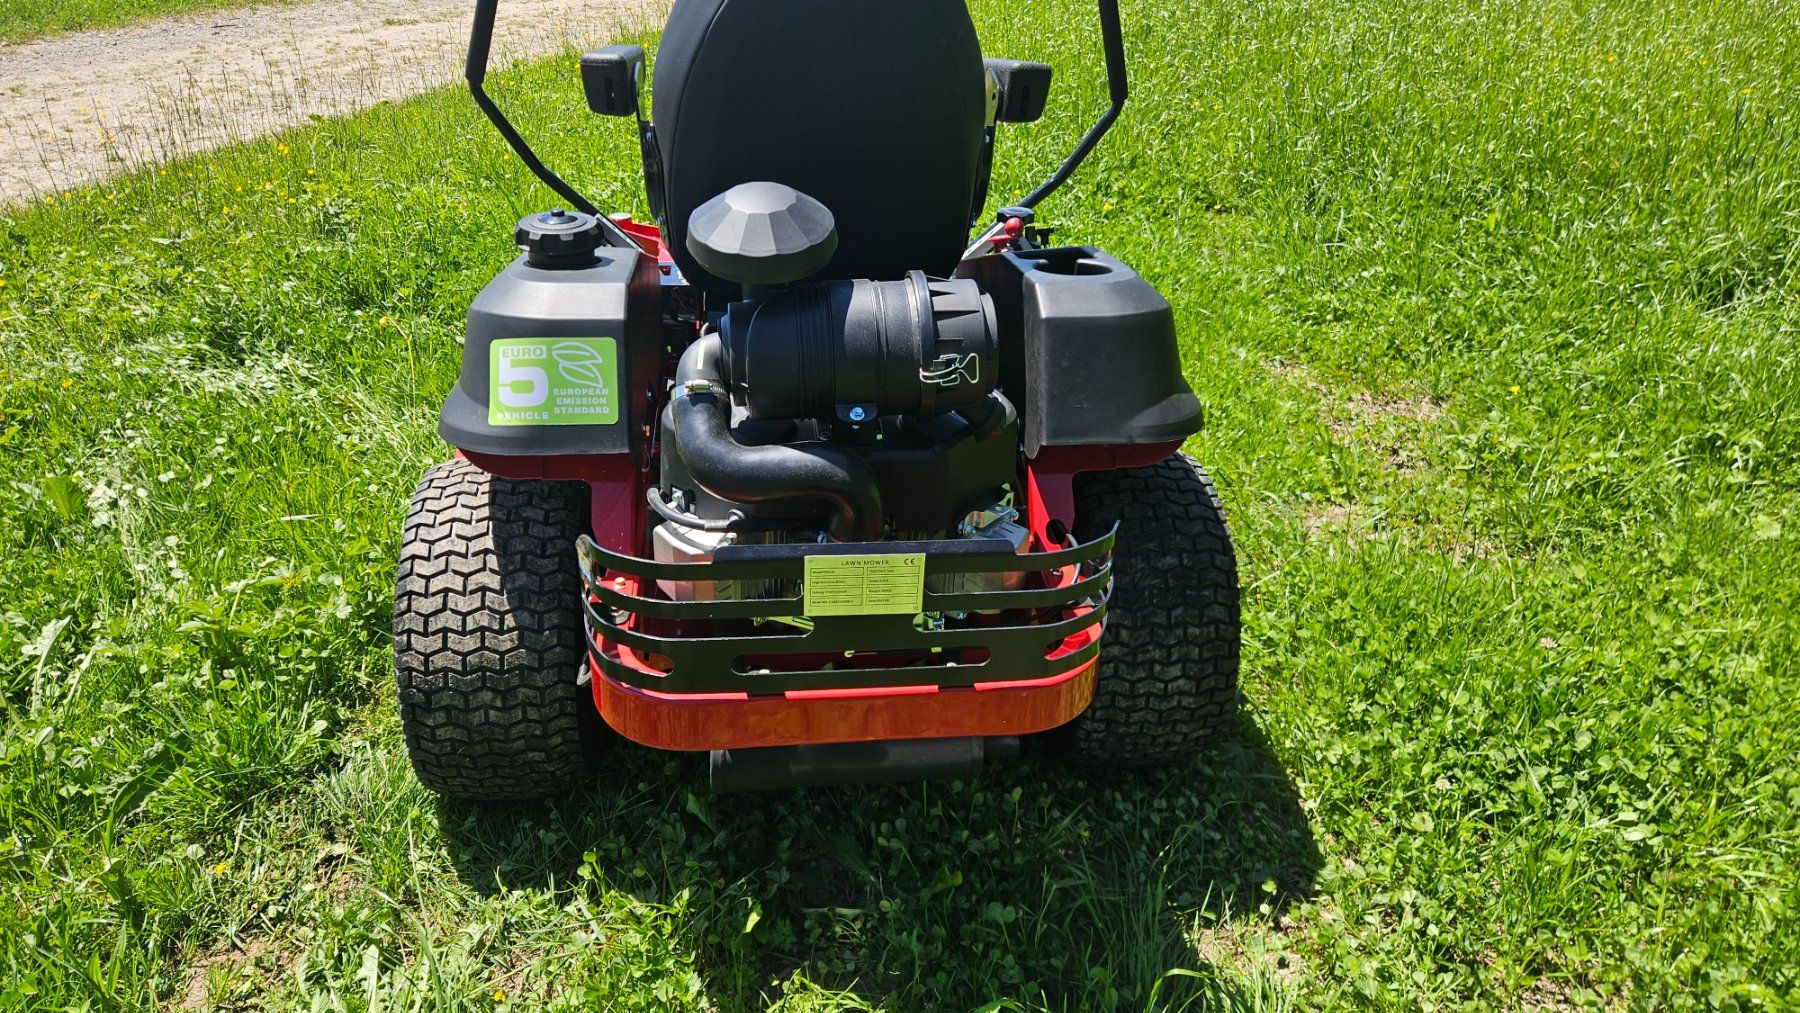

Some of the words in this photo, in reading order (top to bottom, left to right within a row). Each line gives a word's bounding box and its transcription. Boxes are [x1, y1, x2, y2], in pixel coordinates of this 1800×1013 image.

[502, 347, 544, 358] EURO
[498, 346, 549, 408] 5
[556, 397, 607, 405] EMISSION
[497, 411, 550, 420] VEHICLE
